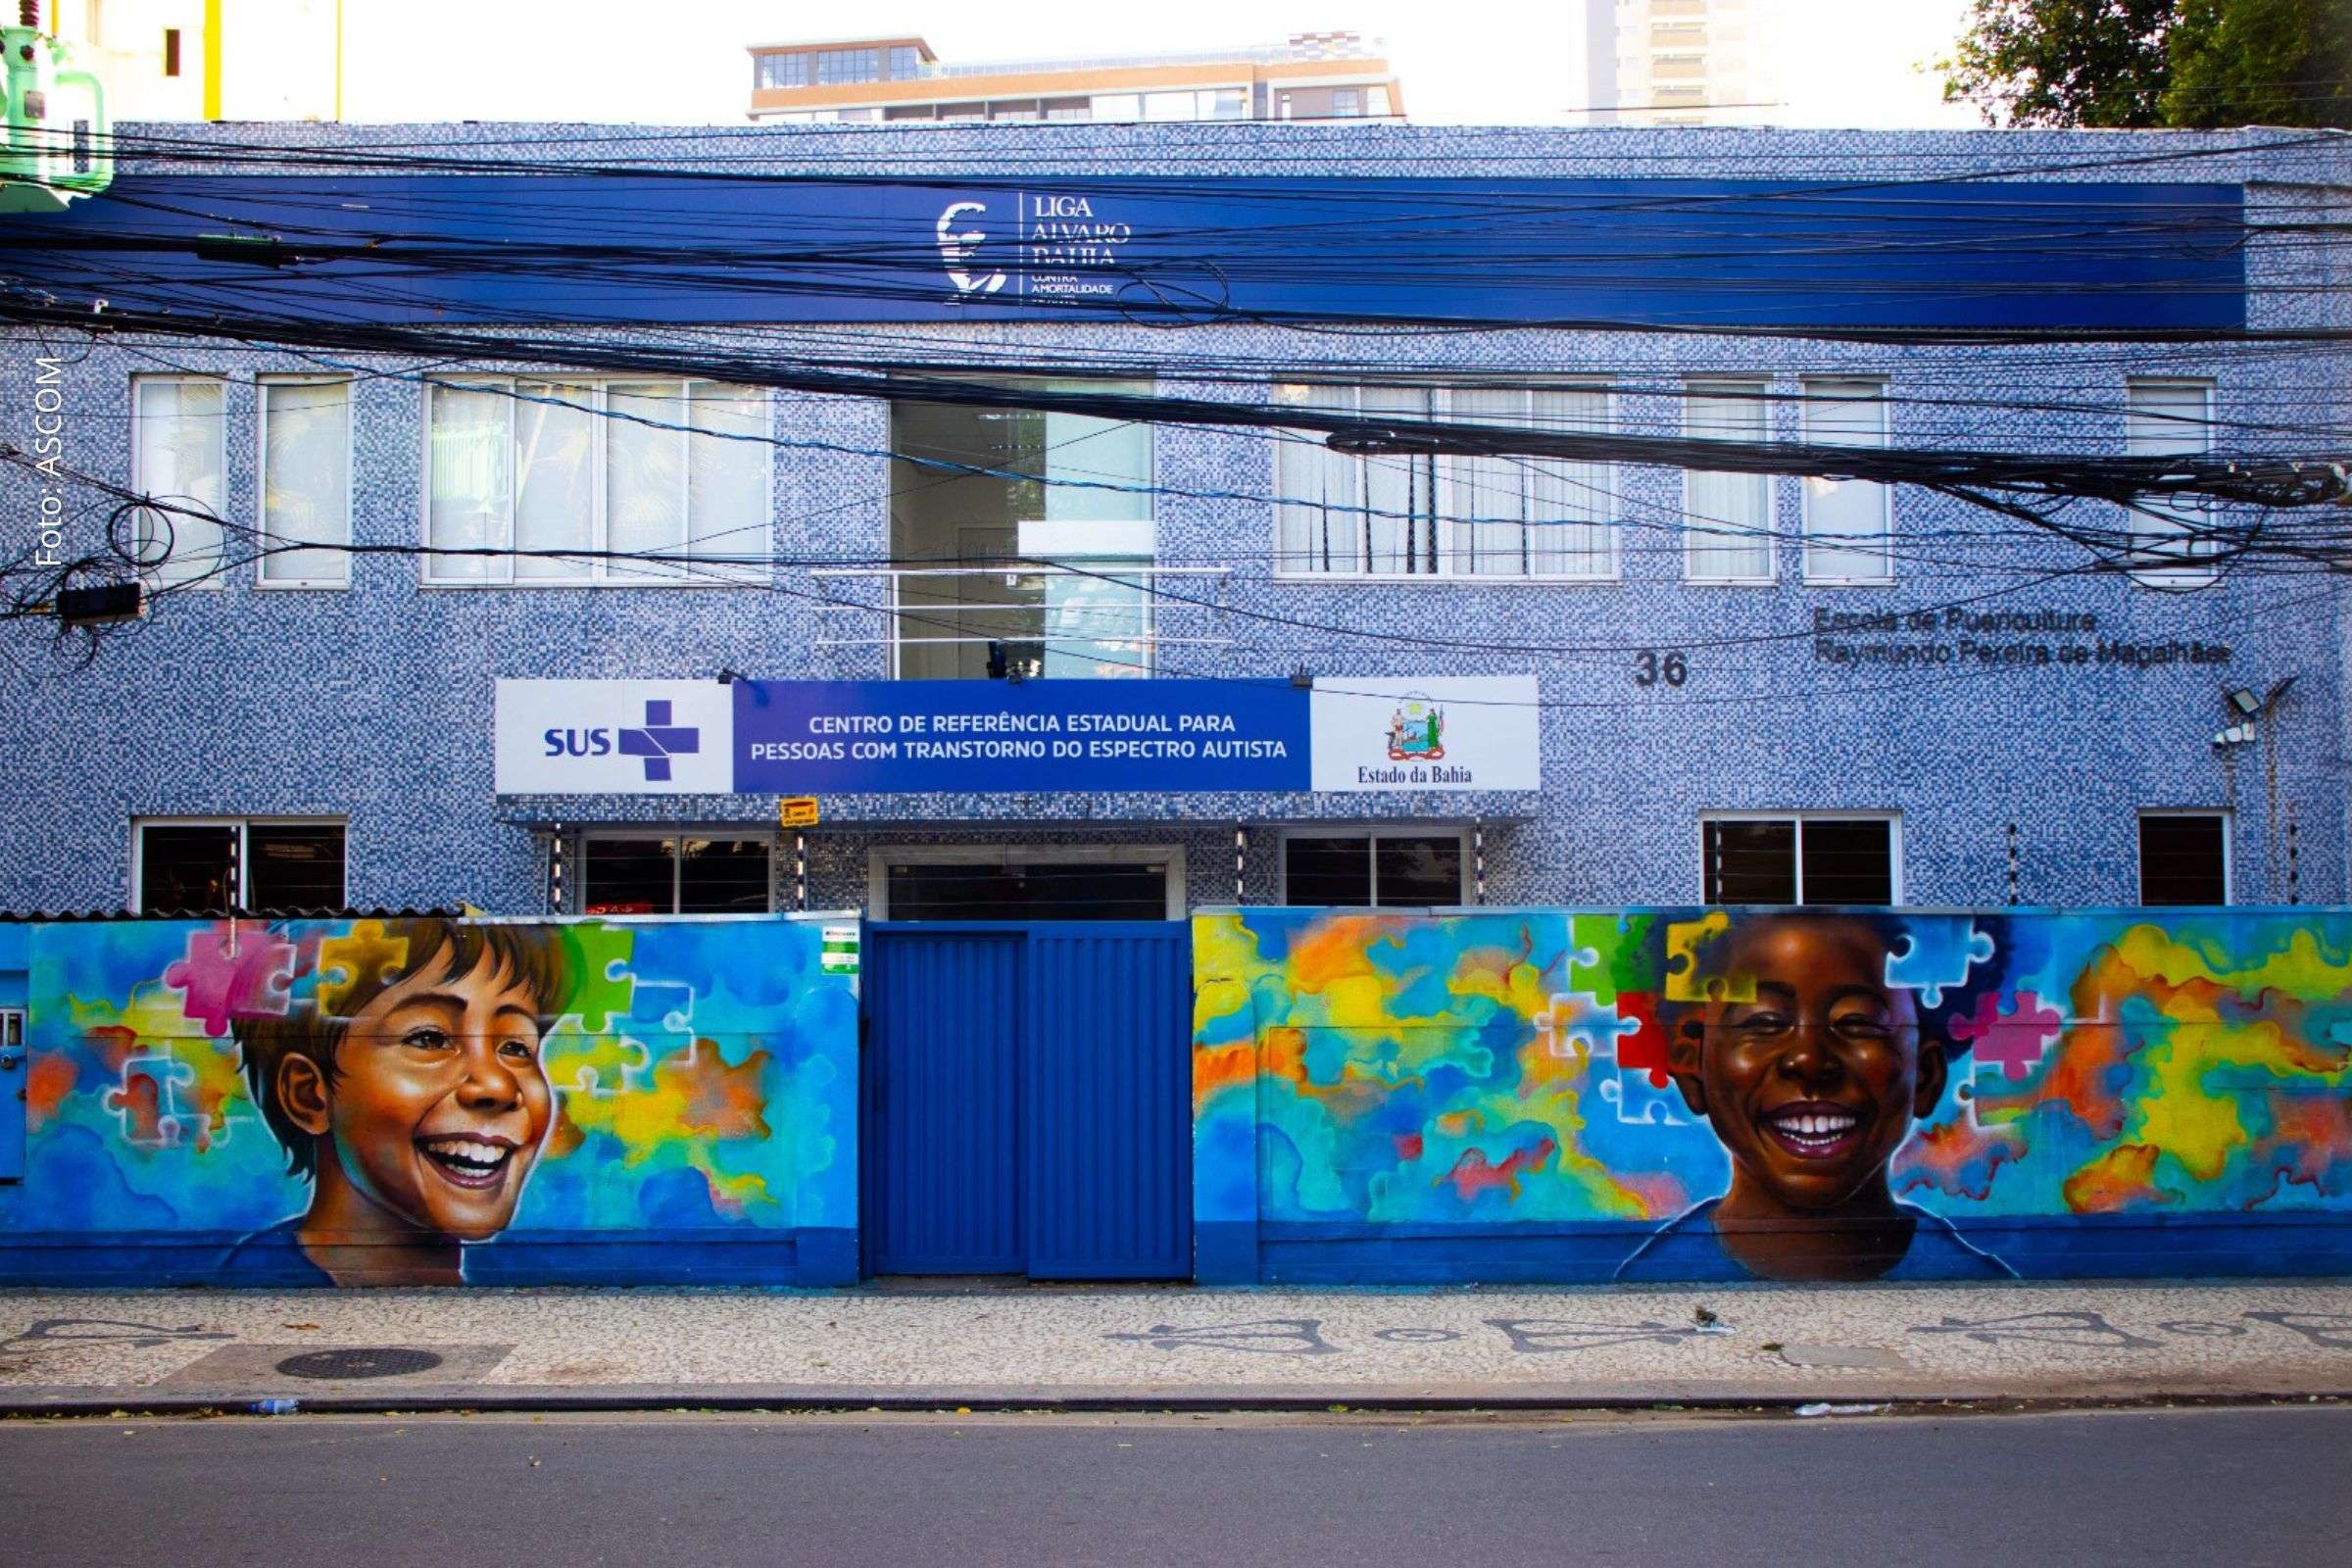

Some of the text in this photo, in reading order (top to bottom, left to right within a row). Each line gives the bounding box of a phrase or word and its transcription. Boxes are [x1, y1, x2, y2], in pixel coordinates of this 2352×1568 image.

[1034, 196, 1094, 218] LIGA
[1636, 650, 1688, 686] 36
[808, 710, 1235, 734] CENTRO DE REFERÊNCIA ESTADUAL PARA
[544, 727, 612, 758] SUS
[751, 740, 1287, 760] PESSOAS COM TRANSTORNO DO ESPECTRO AUTISTA
[1357, 764, 1473, 784] Estado da Bahia
